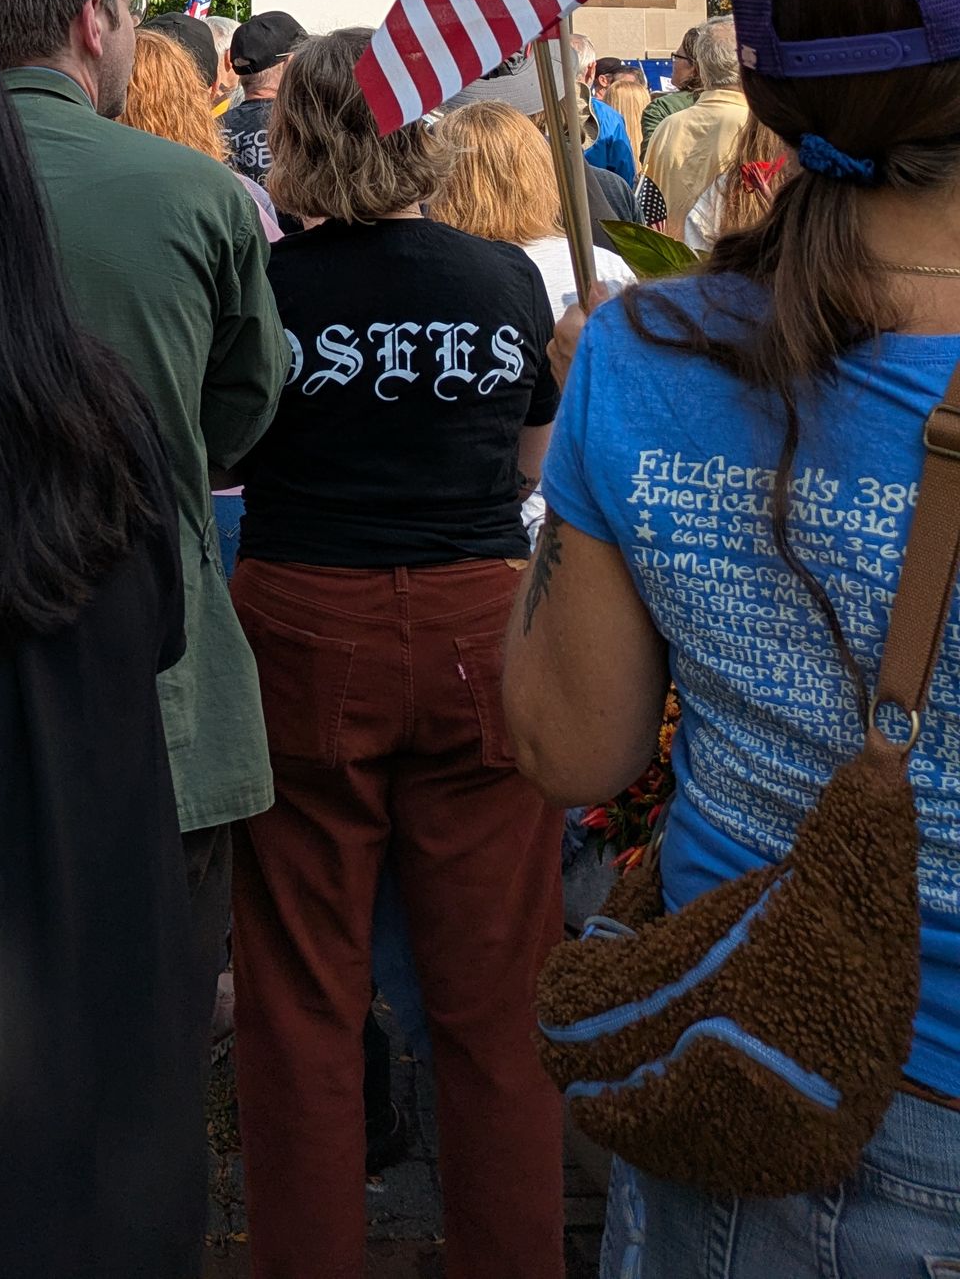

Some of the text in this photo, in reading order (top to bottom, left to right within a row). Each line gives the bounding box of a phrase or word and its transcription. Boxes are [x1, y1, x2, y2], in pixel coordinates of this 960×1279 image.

[631, 449, 920, 513] FitzGerad's 38t
[787, 499, 899, 538] Music
[631, 545, 671, 568] JD
[671, 529, 718, 548] 6615
[721, 535, 746, 551] W.
[753, 538, 849, 567] Roevelt
[673, 571, 757, 599] Benoit
[773, 586, 875, 622] Macia
[691, 608, 807, 639] Suffers
[708, 595, 799, 622] Shook
[836, 610, 882, 638] he
[787, 638, 876, 669] becoes
[793, 670, 834, 692] the
[786, 688, 856, 710] Robbie
